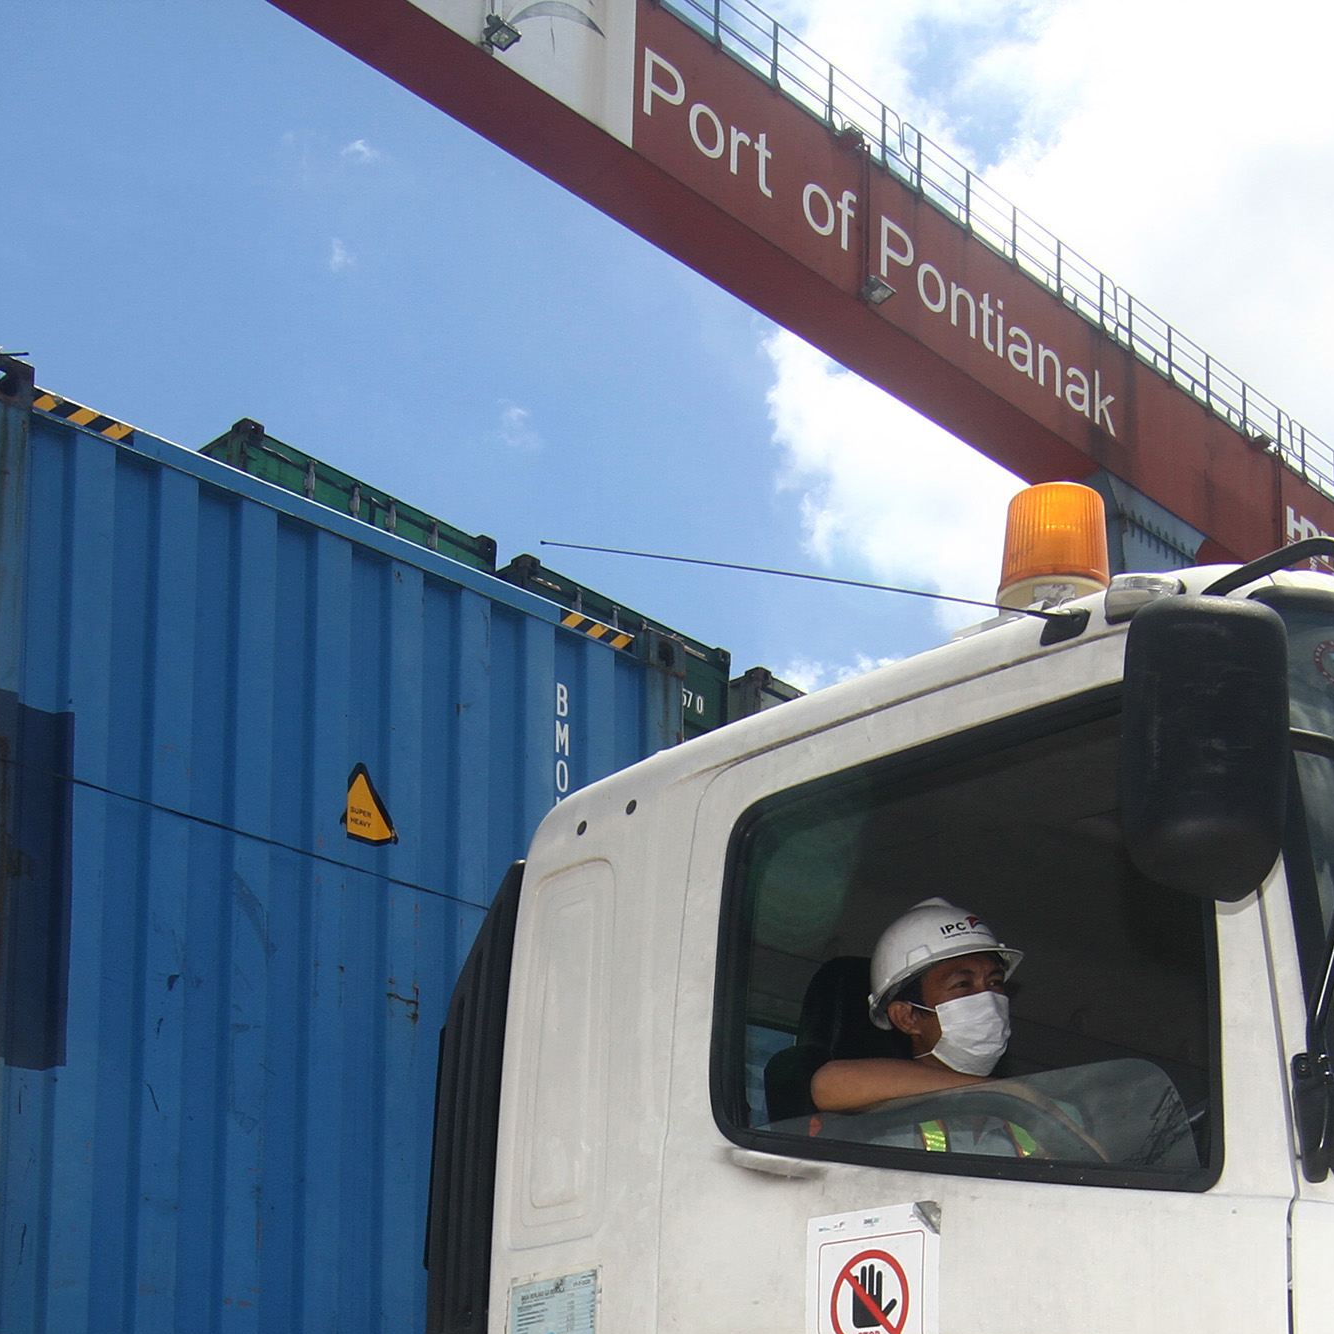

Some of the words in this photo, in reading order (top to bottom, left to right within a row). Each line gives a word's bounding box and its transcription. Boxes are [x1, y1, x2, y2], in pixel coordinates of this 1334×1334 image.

[641, 46, 774, 200] Port
[801, 181, 858, 252] of
[878, 214, 1116, 438] Pontianak
[555, 682, 570, 806] BMO
[350, 806, 372, 819] SUPER
[350, 817, 372, 829] HEAVY
[940, 922, 967, 935] IPC
